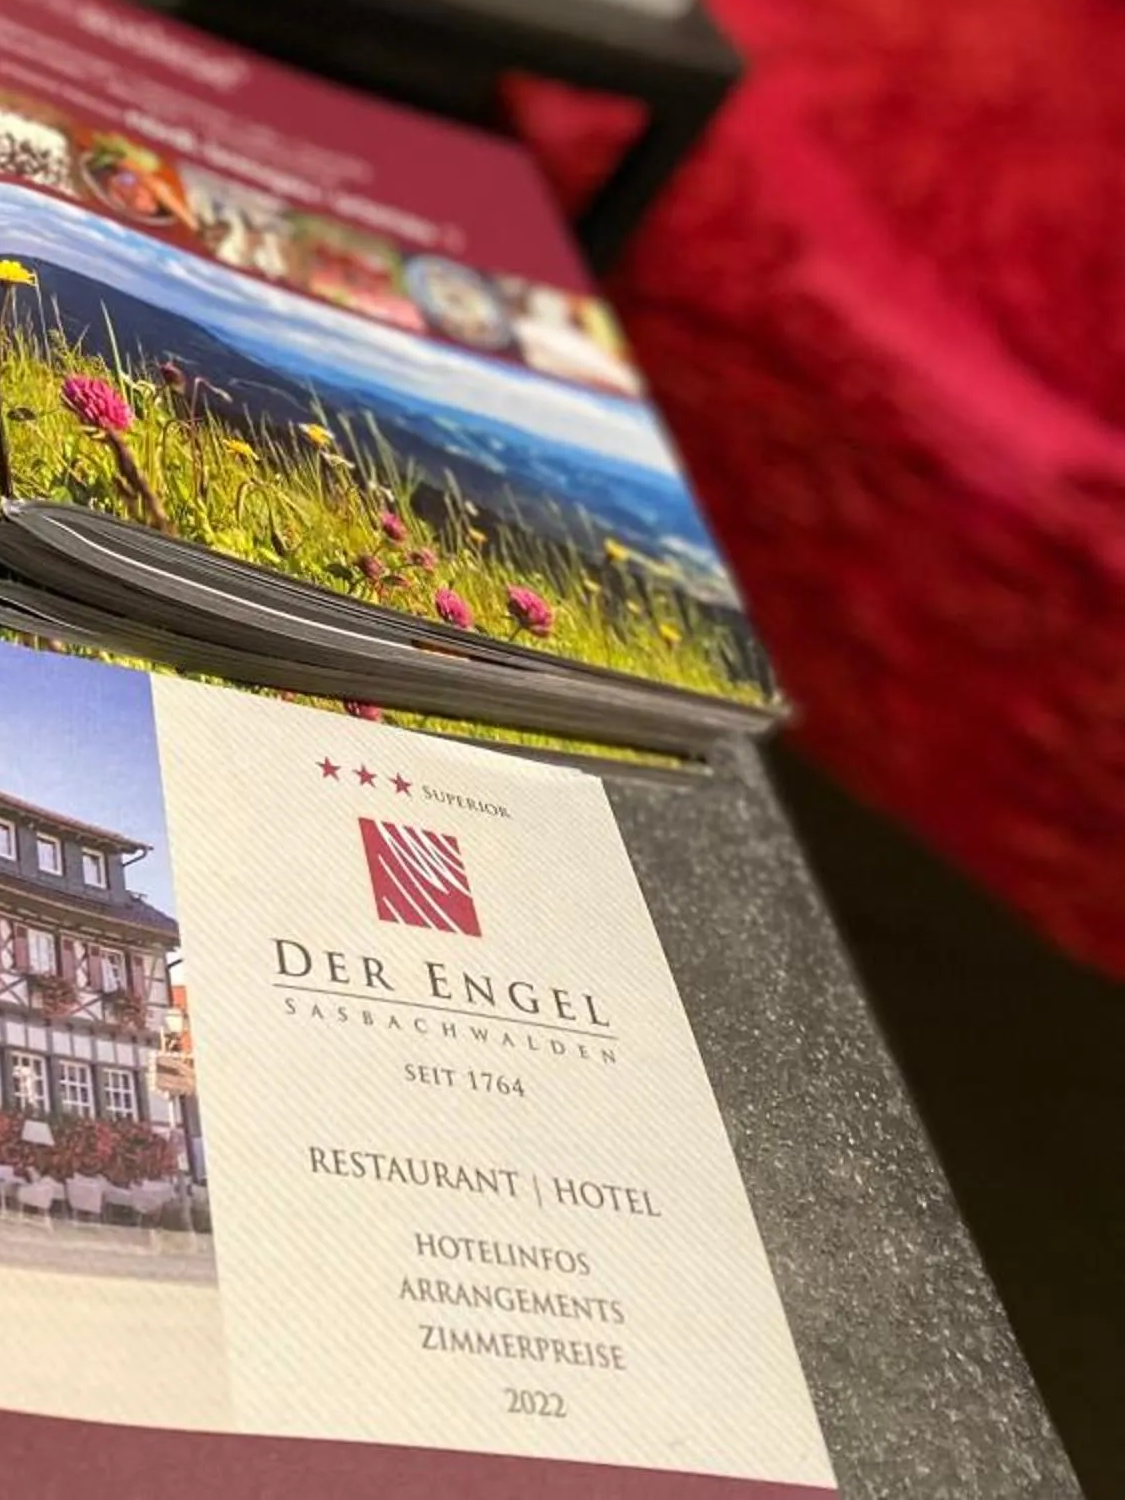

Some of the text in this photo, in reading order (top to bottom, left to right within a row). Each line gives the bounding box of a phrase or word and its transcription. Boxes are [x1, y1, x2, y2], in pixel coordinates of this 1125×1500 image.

[421, 784, 513, 820] SUPERIOR
[271, 937, 611, 1029] DER ENGEL
[284, 996, 617, 1065] SASBACHWALDEN
[403, 1062, 526, 1098] SEIT 1764
[308, 1145, 519, 1198] RESTAURANT
[552, 1176, 663, 1218] HOTEL
[414, 1232, 591, 1277] HOTELINFOS
[398, 1275, 627, 1325] ARRANGEMENTS
[417, 1324, 627, 1371] ZIMMERPREISE
[503, 1386, 568, 1419] 2022
